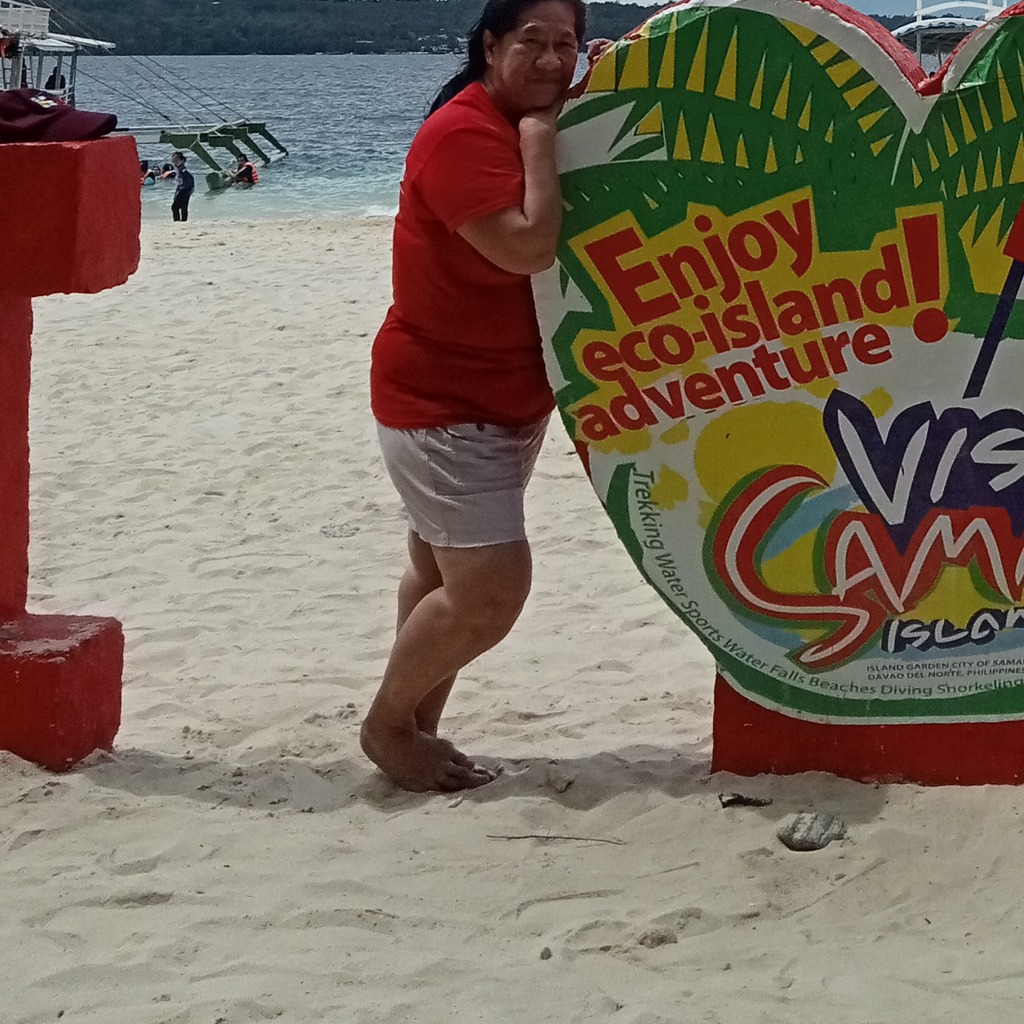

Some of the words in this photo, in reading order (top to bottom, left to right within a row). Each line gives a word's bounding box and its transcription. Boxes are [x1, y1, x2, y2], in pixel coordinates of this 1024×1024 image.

[584, 198, 814, 326] Enjoy
[576, 322, 892, 442] adventure
[632, 470, 665, 550] Trekking
[655, 553, 689, 598] Water
[681, 600, 725, 642] Sports
[724, 638, 769, 670] Water
[770, 664, 804, 683] Falls
[809, 676, 876, 694] Beaches
[881, 685, 933, 697] Diving
[866, 664, 905, 672] ISLAND
[867, 672, 905, 680] DAVAO
[907, 671, 926, 679] DEL
